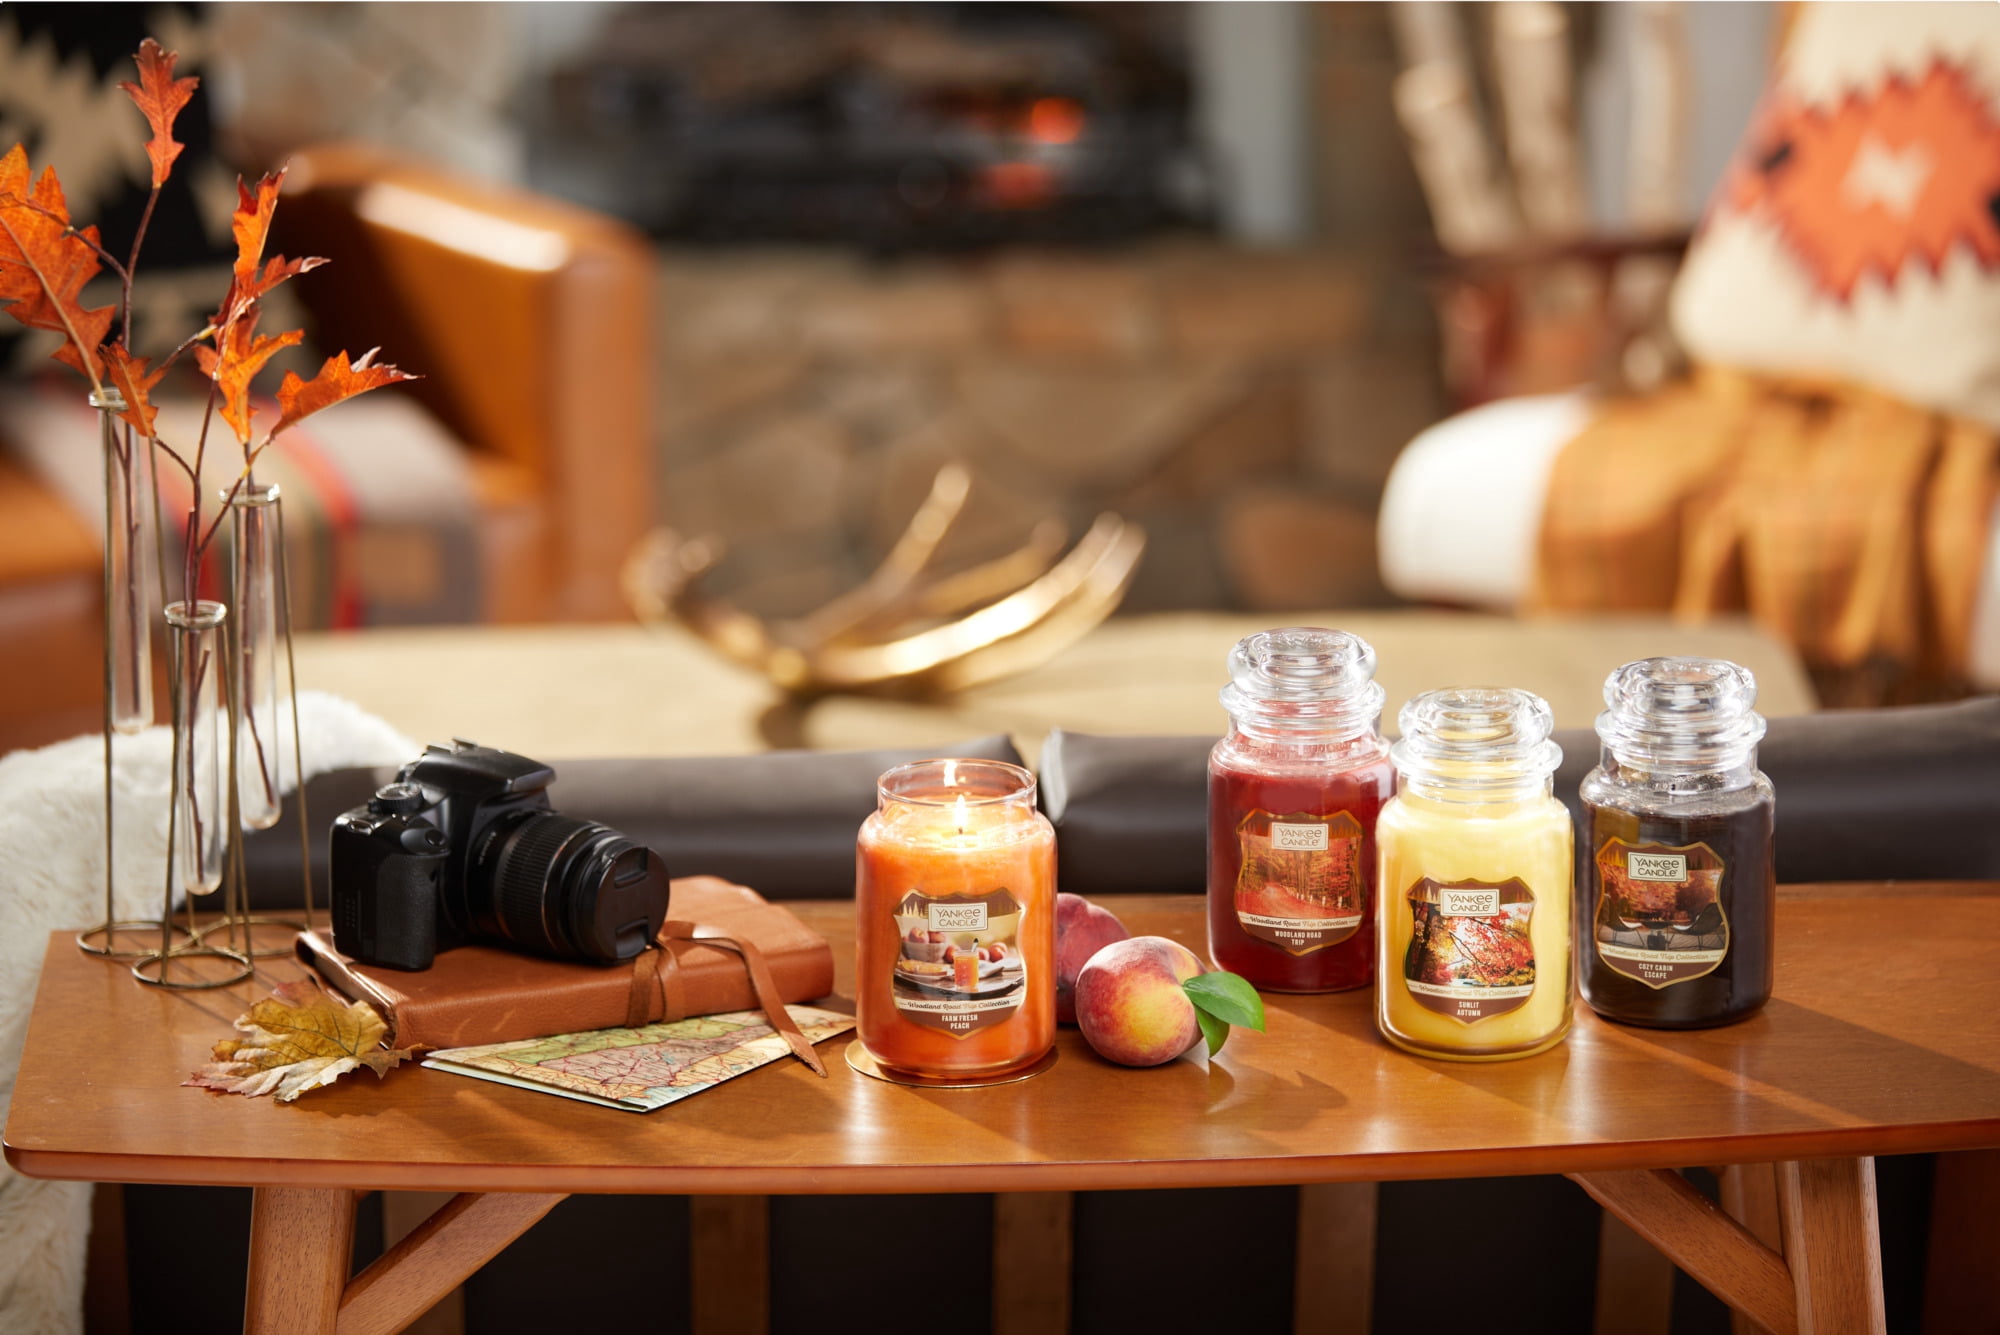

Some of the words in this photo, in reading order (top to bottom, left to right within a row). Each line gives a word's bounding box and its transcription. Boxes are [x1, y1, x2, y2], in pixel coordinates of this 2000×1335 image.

[1250, 916, 1282, 926] Woodland
[1303, 920, 1315, 928] Trip
[1317, 919, 1348, 927] Collection
[907, 1002, 942, 1010] Woodland
[978, 1000, 1010, 1008] Collection
